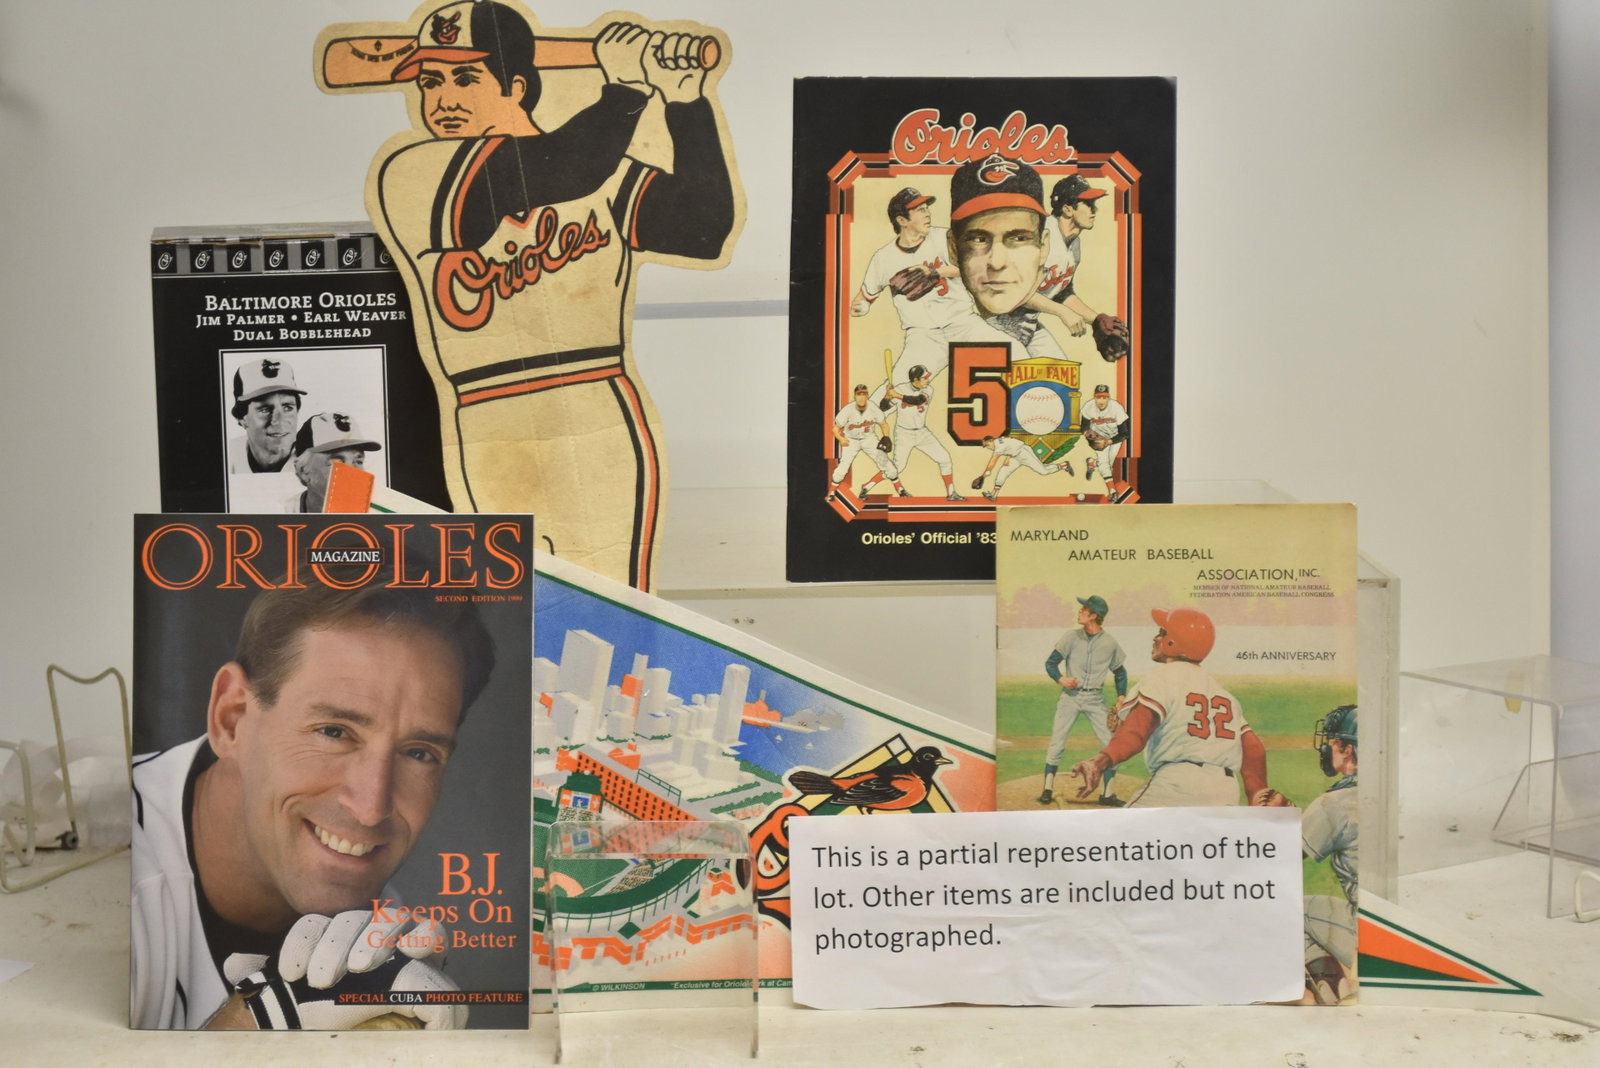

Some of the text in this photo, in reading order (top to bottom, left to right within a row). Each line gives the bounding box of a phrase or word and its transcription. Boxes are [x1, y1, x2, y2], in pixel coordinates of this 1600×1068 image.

[892, 108, 1075, 165] Orioles
[433, 206, 611, 332] Orioles
[205, 292, 396, 311] BALTIMORE ORIOLES
[196, 310, 407, 328] JIM PALMER EARL WEAVER
[233, 327, 372, 341] DUAL BOBBLEHEAD
[1005, 366, 1037, 385] HALL
[1046, 366, 1077, 387] FAME
[948, 342, 1012, 446] 5
[861, 532, 915, 544] Orioles'
[921, 532, 972, 544] Official
[1010, 529, 1089, 541] MARYLAND
[142, 522, 525, 590] ORIOLES
[311, 550, 380, 563] MAGAZINE
[1068, 548, 1214, 561] AMATEUR BASEBALL
[1197, 569, 1320, 581] ASSOCIATION, INC.
[1236, 651, 1336, 661] 46th ANNIVERSARY
[1186, 692, 1235, 740] 32
[812, 836, 1276, 871] This is a partial representation of the
[437, 852, 502, 896] B.J.
[814, 878, 1275, 909] lot. Other items are included but not
[370, 898, 513, 931] Keeps On
[367, 931, 517, 953] Getting Better
[815, 923, 1001, 955] photographed.
[600, 983, 645, 991] WILKINSON
[711, 981, 722, 989] for
[339, 994, 523, 1004] SPECIAL CUBA PHOTO FEATURE
